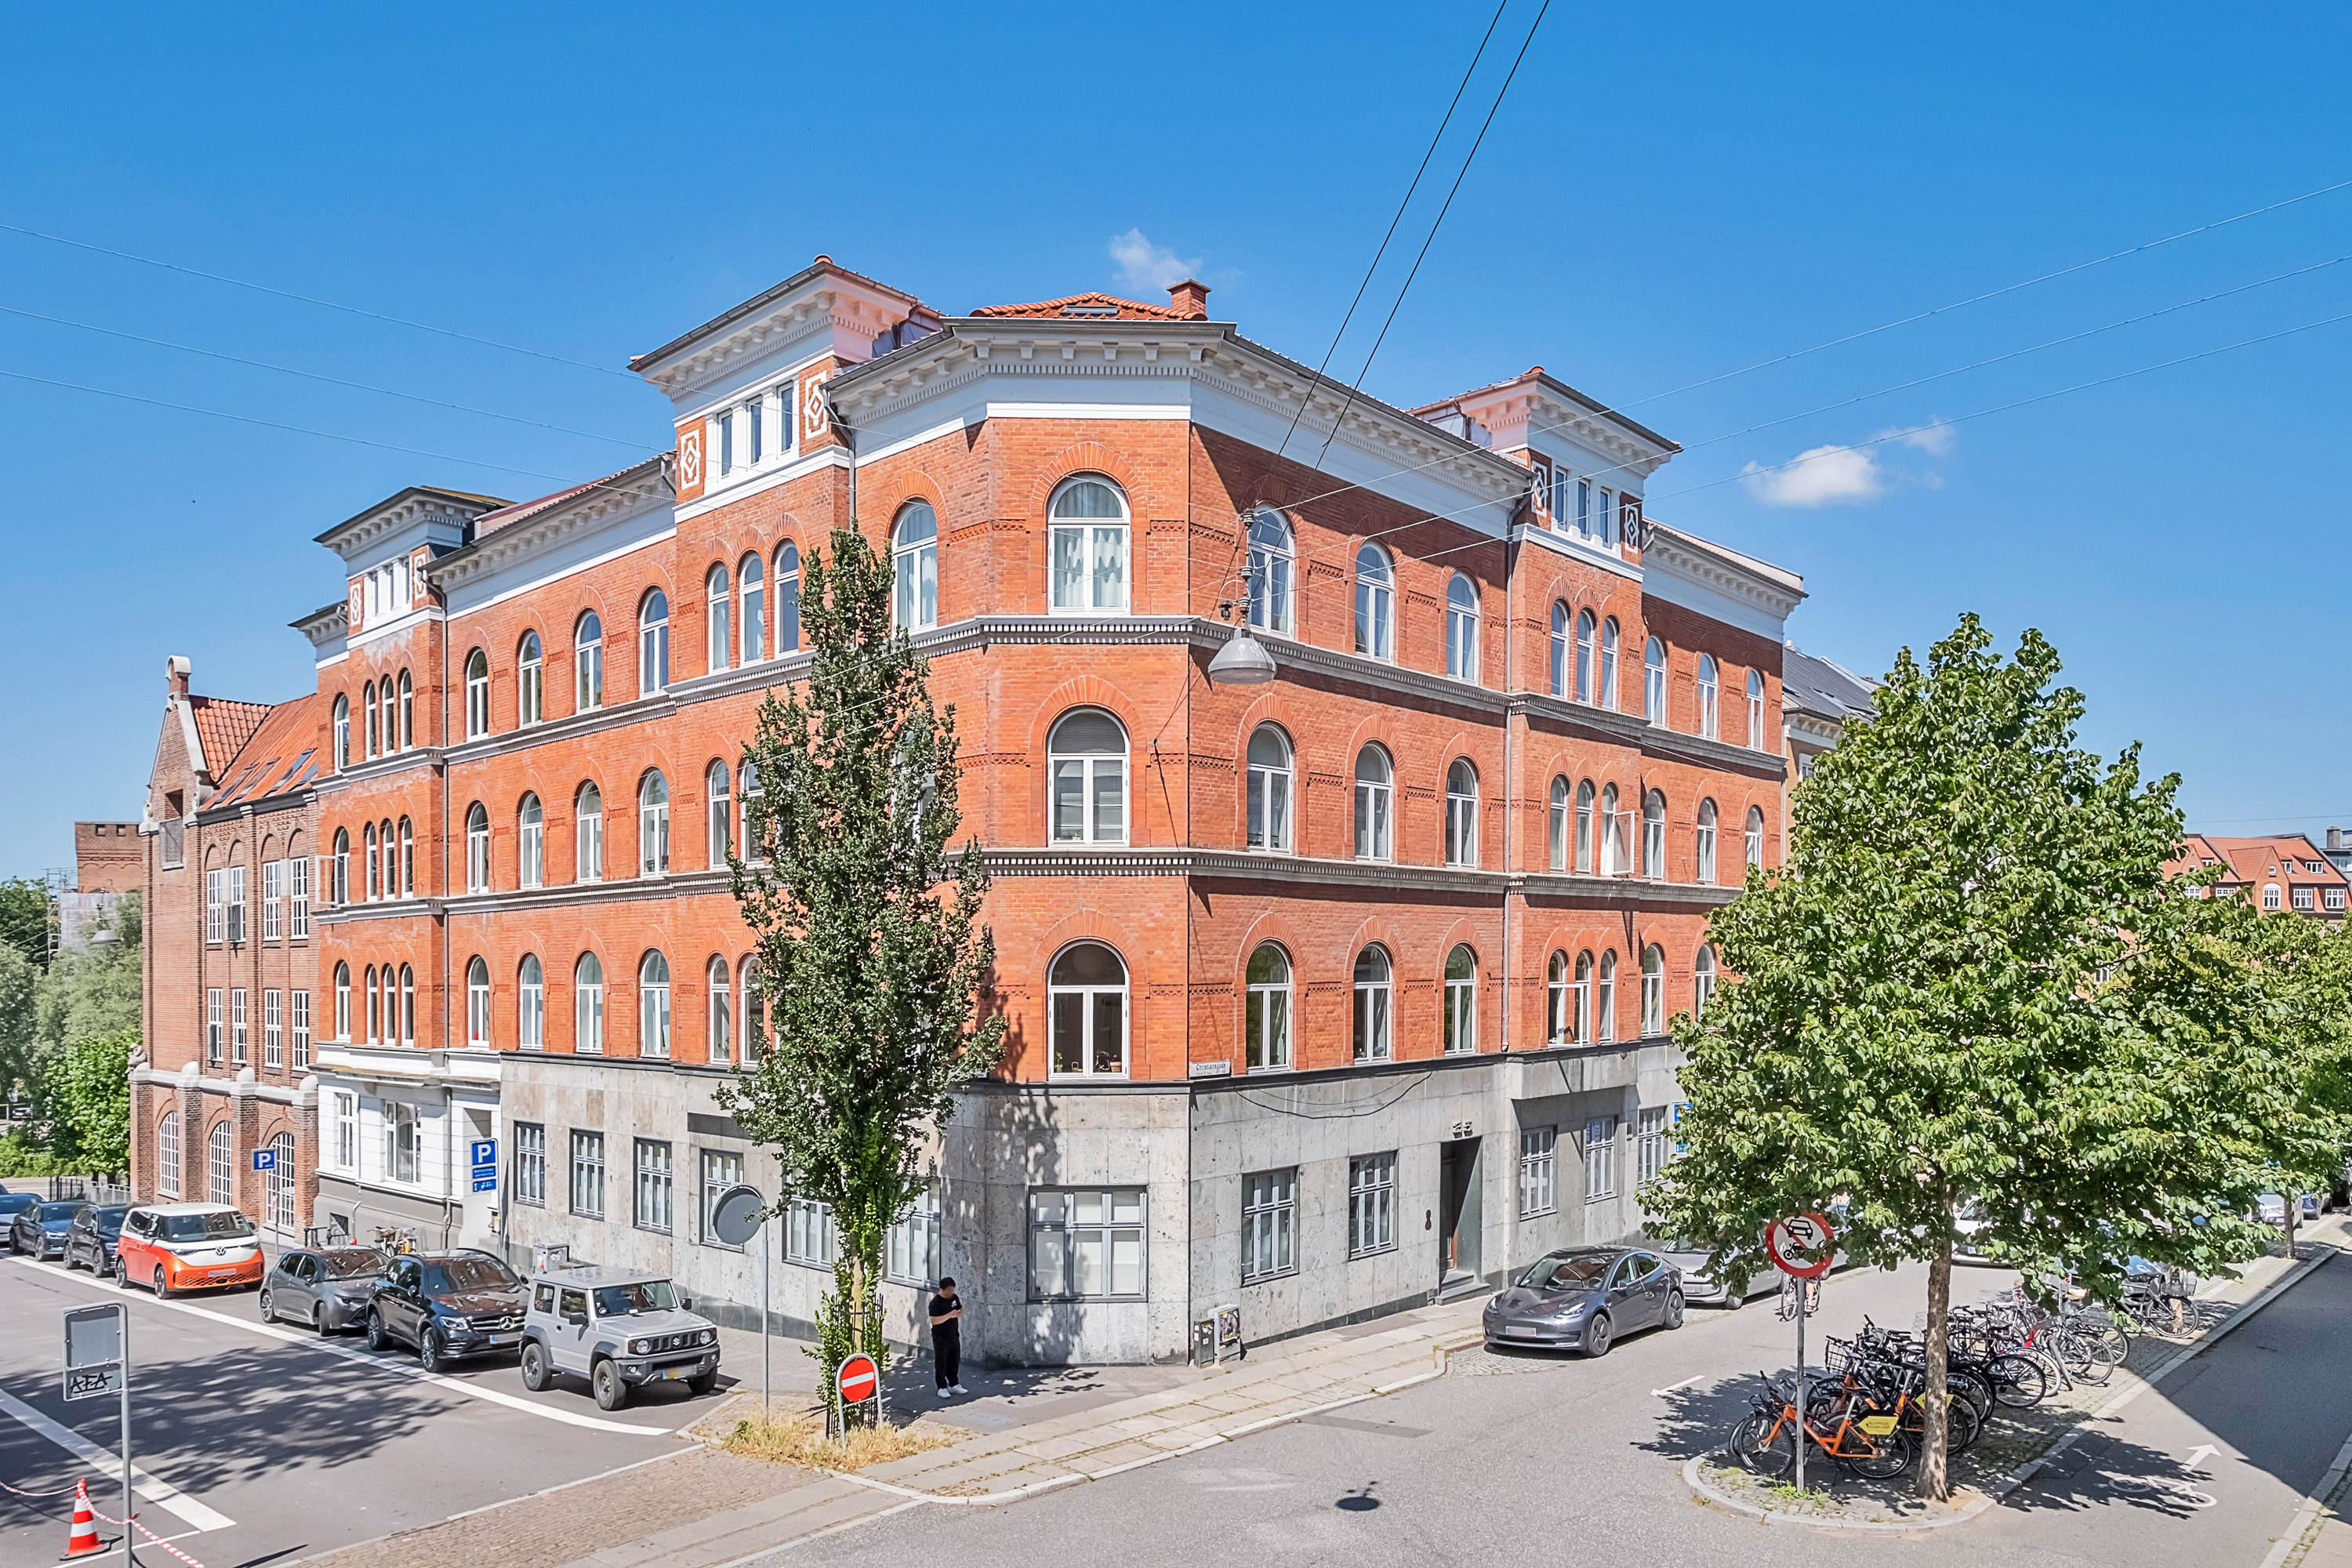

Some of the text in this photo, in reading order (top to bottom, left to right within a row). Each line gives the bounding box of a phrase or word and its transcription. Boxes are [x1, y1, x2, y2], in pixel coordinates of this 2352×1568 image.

[259, 1152, 271, 1168] P
[477, 1144, 492, 1163] P
[70, 1372, 113, 1393] AFA
